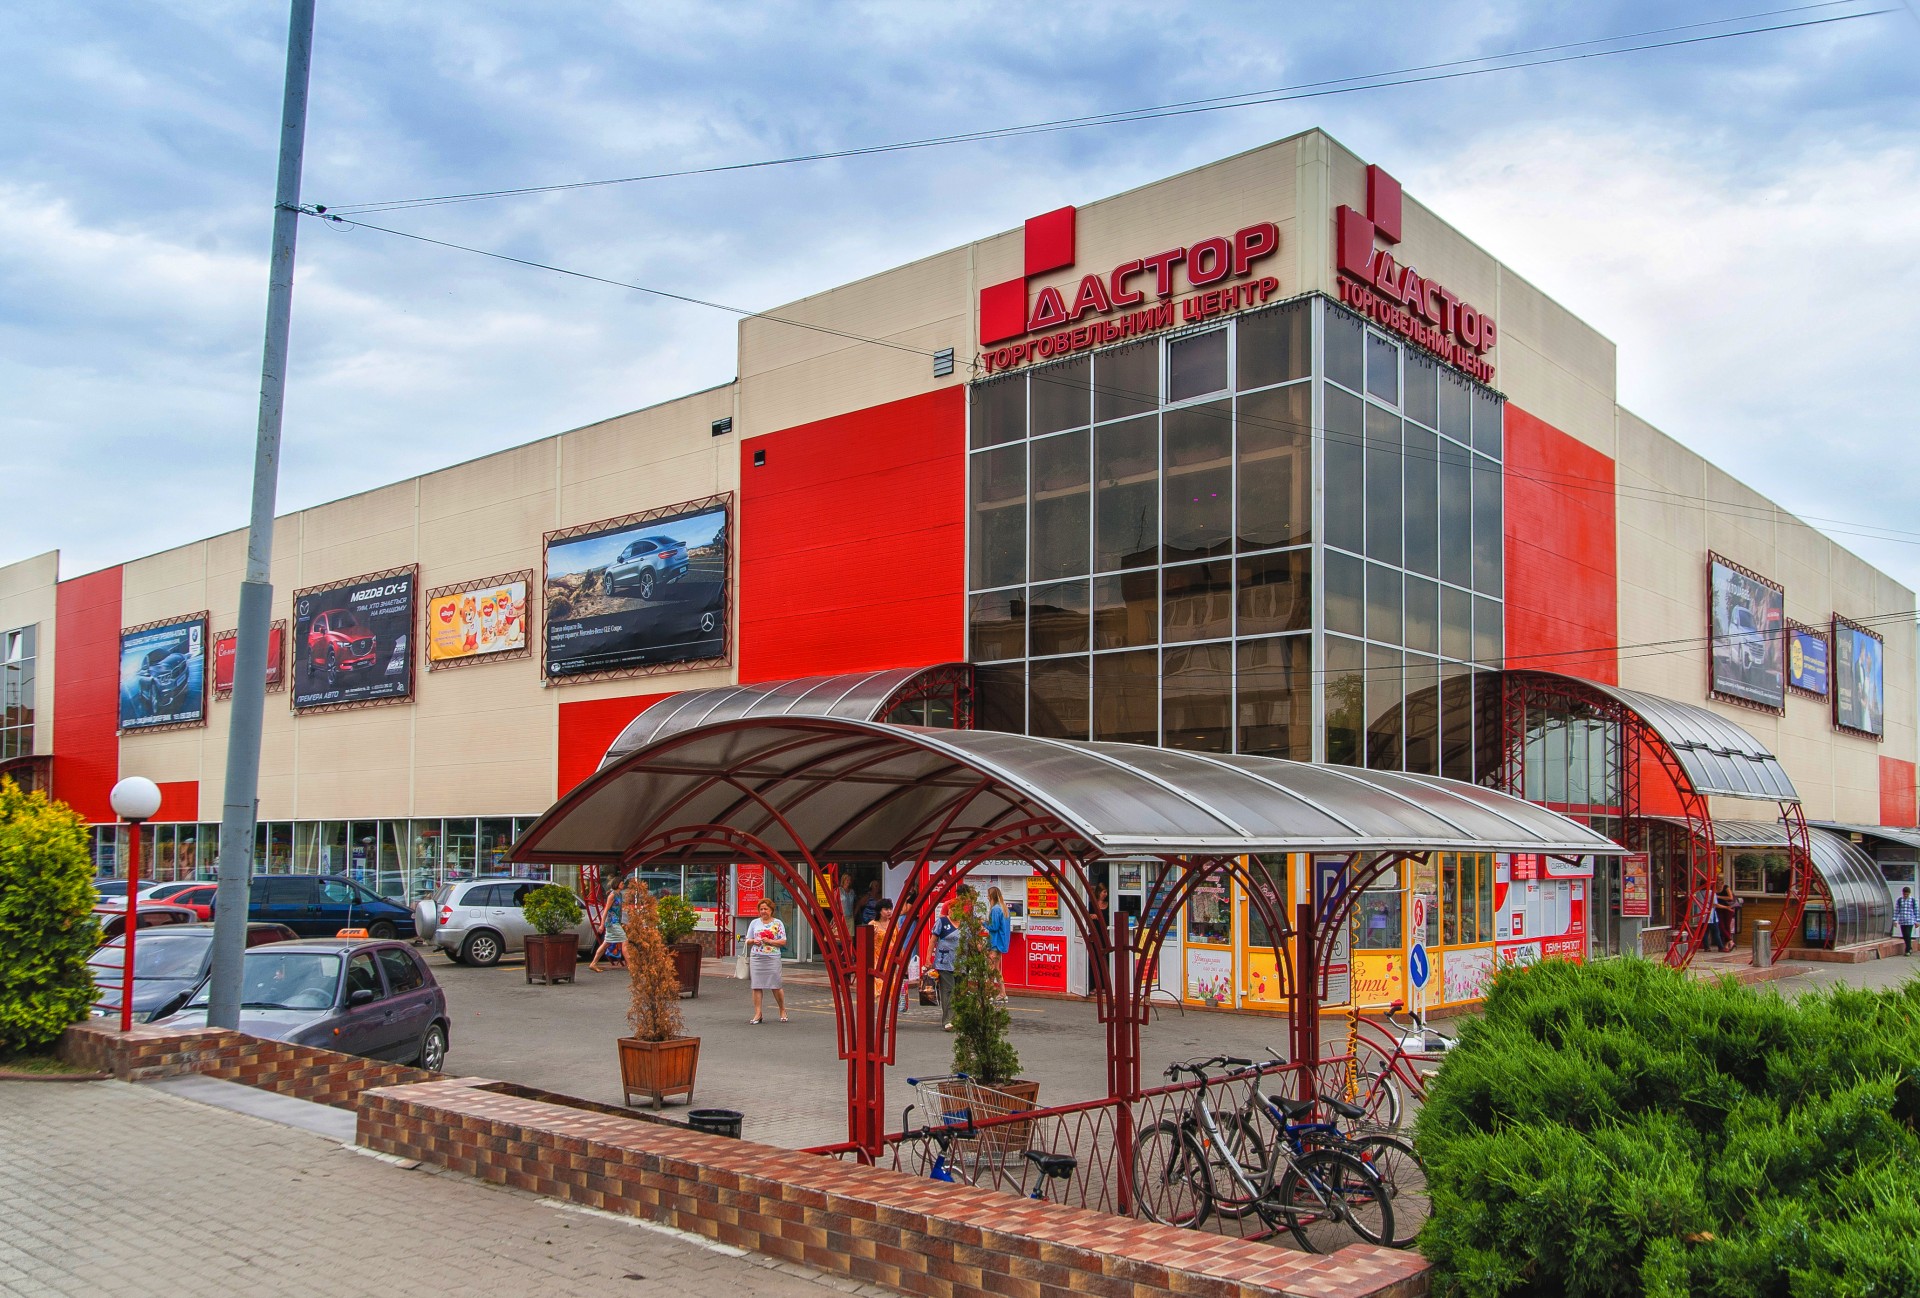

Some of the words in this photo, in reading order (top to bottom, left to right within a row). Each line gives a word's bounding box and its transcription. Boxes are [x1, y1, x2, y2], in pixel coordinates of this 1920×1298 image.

[1027, 221, 1279, 332] ДАСТОР
[1375, 250, 1498, 355] ДАСТОР
[981, 300, 1175, 373] ТОРГОВЕЛЬНИЙ
[1182, 276, 1279, 322] ЦЕНТР
[1337, 276, 1454, 361] ТОРГОВЕЛЬНИЙ
[1452, 345, 1496, 384] ЦЕНТР
[385, 582, 408, 596] CX-5
[369, 602, 380, 610] ХТО
[579, 628, 603, 636] Mercedes-Benz
[324, 690, 340, 700] АВТО
[1323, 869, 1340, 916] P
[1030, 942, 1060, 952] ОБМІН
[1545, 943, 1561, 953] ОБМІН
[1562, 940, 1581, 951] ВАЛЮТ
[1028, 952, 1063, 963] ВАЛЮТ
